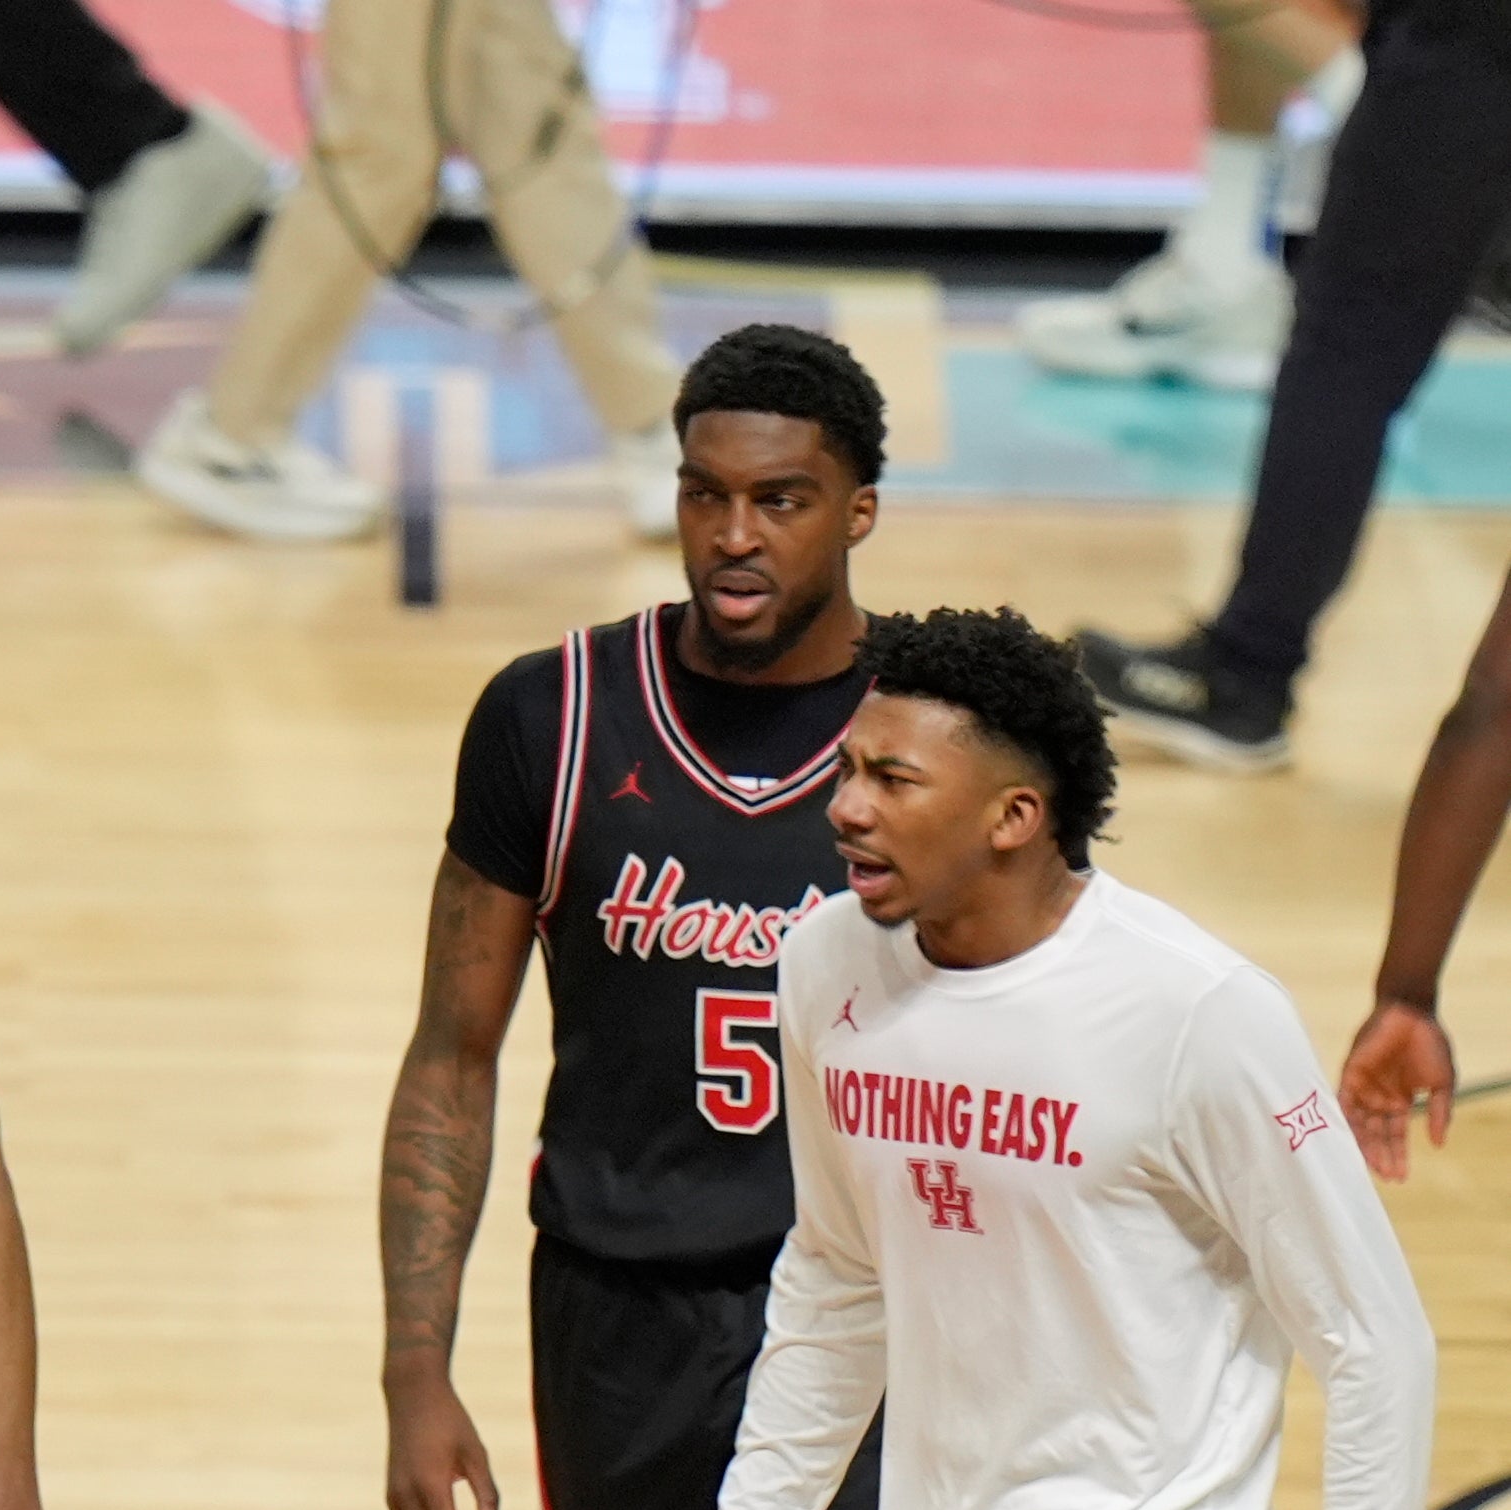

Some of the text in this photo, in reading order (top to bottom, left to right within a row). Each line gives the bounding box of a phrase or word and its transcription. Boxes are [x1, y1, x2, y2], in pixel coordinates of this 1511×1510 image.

[596, 853, 827, 968] Hous
[695, 987, 779, 1135] 5
[825, 1066, 1084, 1167] NOTHING EASY.
